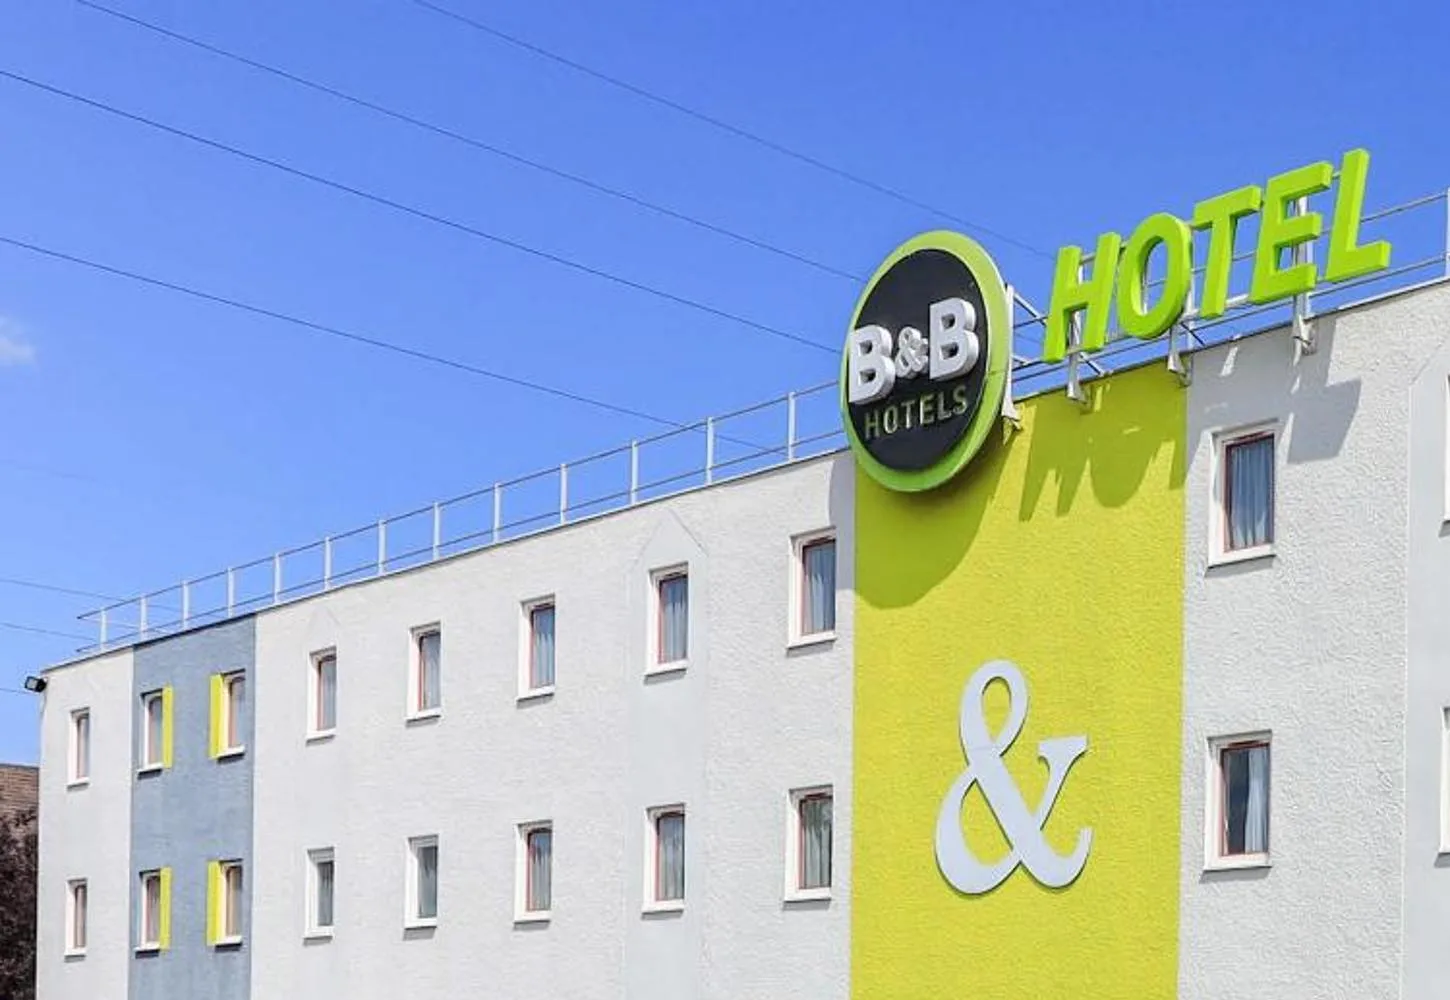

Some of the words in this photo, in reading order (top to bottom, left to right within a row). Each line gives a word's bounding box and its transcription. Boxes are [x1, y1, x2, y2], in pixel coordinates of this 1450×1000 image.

[1043, 148, 1392, 364] HOTEL
[849, 297, 980, 405] B&B
[864, 385, 968, 440] HOTELS
[935, 659, 1094, 898] &
